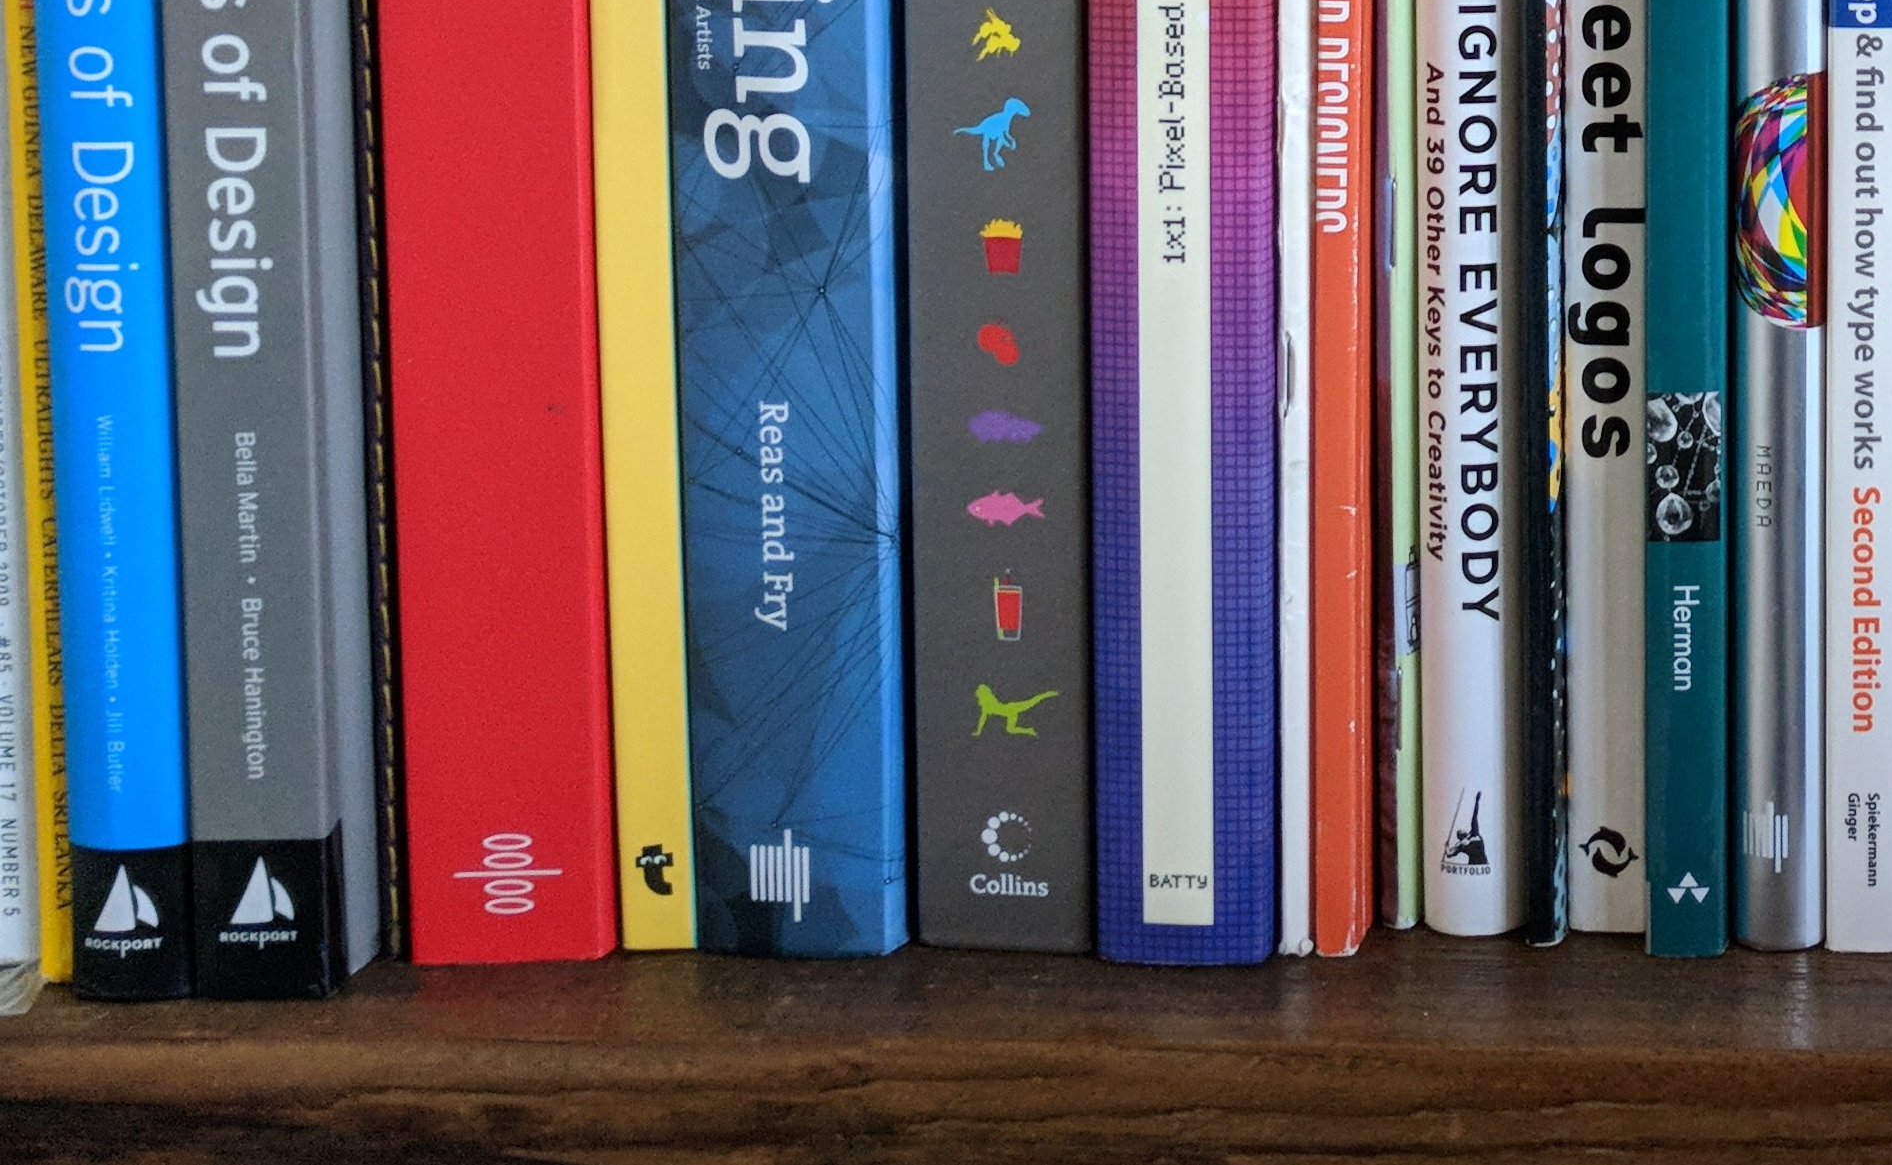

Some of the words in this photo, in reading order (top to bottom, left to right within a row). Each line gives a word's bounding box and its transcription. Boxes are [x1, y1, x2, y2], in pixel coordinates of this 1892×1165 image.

[697, 4, 713, 71] Artists
[23, 85, 43, 181] GUINEA
[1158, 4, 1187, 194] Pixel-Based
[1425, 62, 1446, 126] And
[1457, 4, 1498, 235] IGNORE
[1856, 67, 1885, 132] find
[1855, 148, 1879, 199] out
[27, 192, 48, 321] DELAWARE
[64, 140, 140, 353] Design
[195, 127, 273, 358] Design
[1426, 185, 1446, 276] Other
[1855, 208, 1884, 279] how
[1425, 285, 1445, 357] Keys
[1567, 206, 1646, 458] logos
[1848, 287, 1878, 362] type
[33, 338, 57, 501] ULTRALIGHTS
[95, 414, 114, 478] William
[235, 431, 258, 486] Bella
[758, 400, 790, 485] Reas
[1459, 262, 1500, 621] EVERYBODY
[1852, 370, 1882, 470] works
[1426, 409, 1450, 562] Creativity
[1755, 445, 1773, 529] MAEDA
[237, 491, 262, 564] Martin
[1851, 486, 1882, 607] Second
[40, 516, 65, 687] CATERPILLARS
[240, 596, 263, 661] Bruce
[754, 572, 794, 632] Fry
[1672, 584, 1701, 692] Herman
[103, 629, 121, 689] Holden
[1852, 616, 1883, 733] Edition
[50, 703, 67, 778] DELTA
[241, 667, 268, 781] Hanington
[106, 740, 126, 793] Butler
[1844, 792, 1861, 842] Ginger
[1865, 792, 1881, 888] Spiekermann
[1, 818, 20, 899] NUMBER
[54, 832, 74, 911] LANKA
[969, 872, 1050, 898] Collins
[1149, 873, 1208, 890] BATTY
